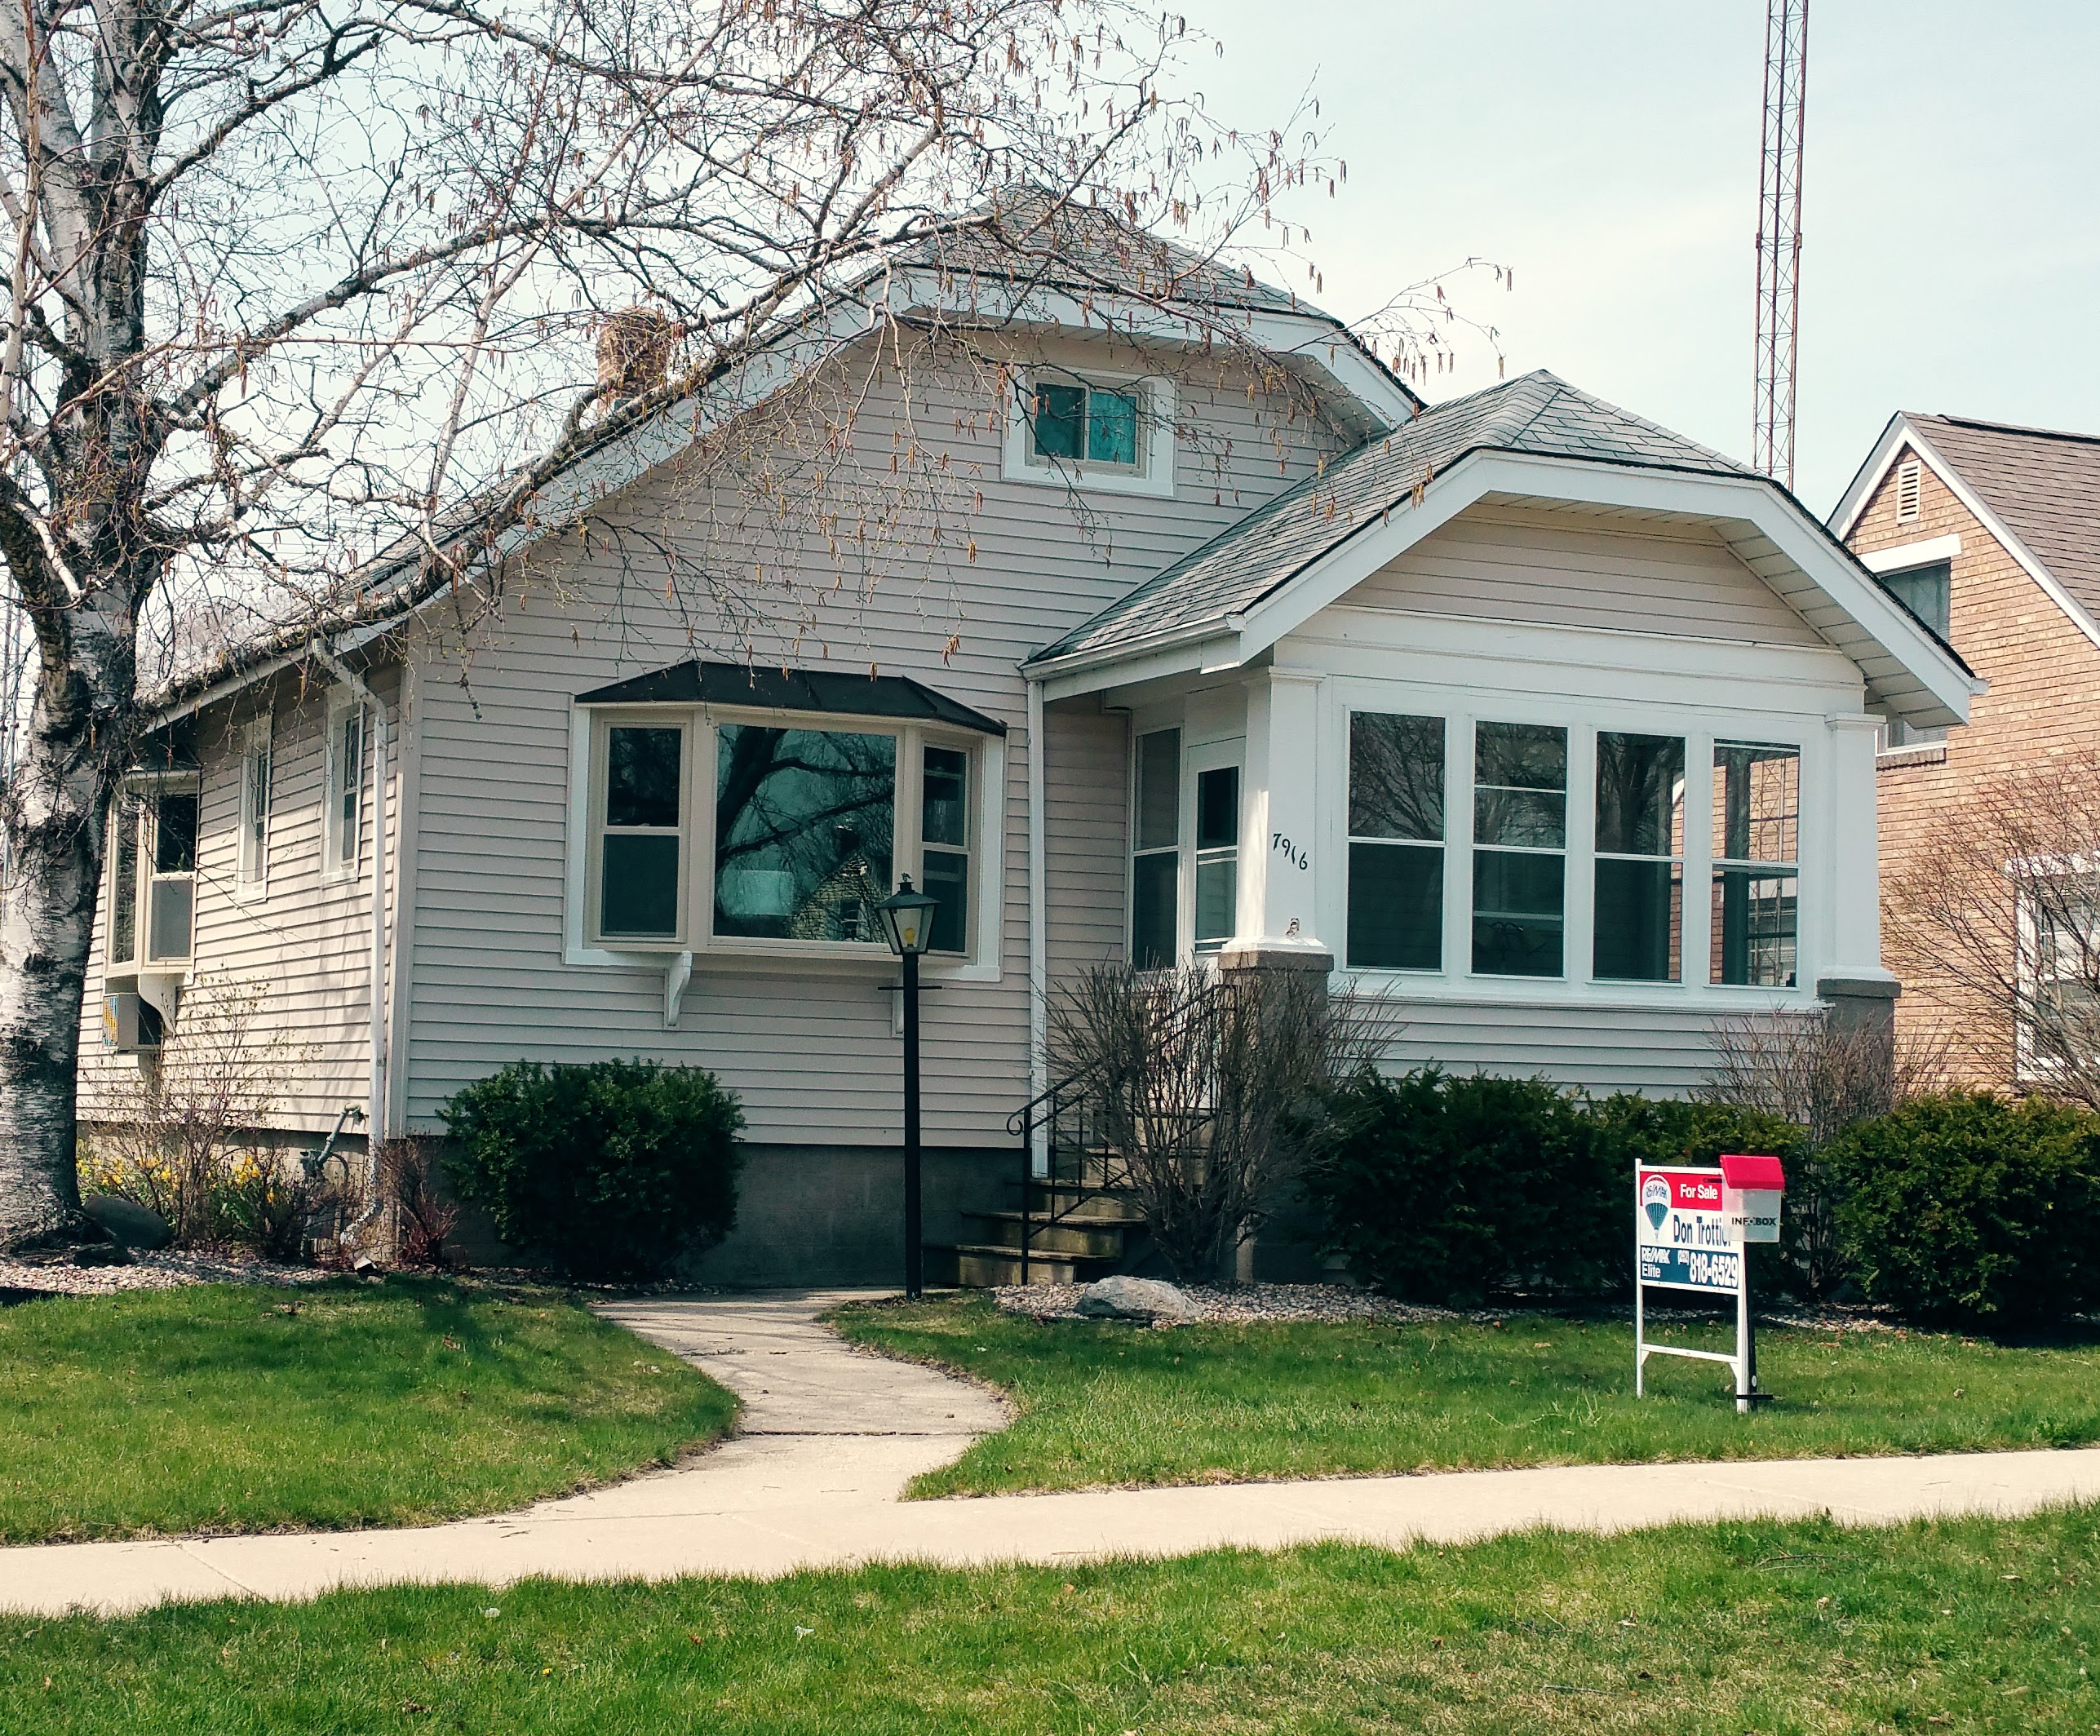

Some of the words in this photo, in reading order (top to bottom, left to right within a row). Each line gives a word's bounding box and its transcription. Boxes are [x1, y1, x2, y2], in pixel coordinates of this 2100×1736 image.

[1273, 833, 1308, 870] 7916
[1680, 1183, 1697, 1198] For
[1697, 1184, 1718, 1200] Sale
[1673, 1214, 1693, 1243] Don
[1696, 1216, 1730, 1247] Trotti
[1641, 1262, 1661, 1278] Elite
[1689, 1251, 1739, 1288] 818-6529
